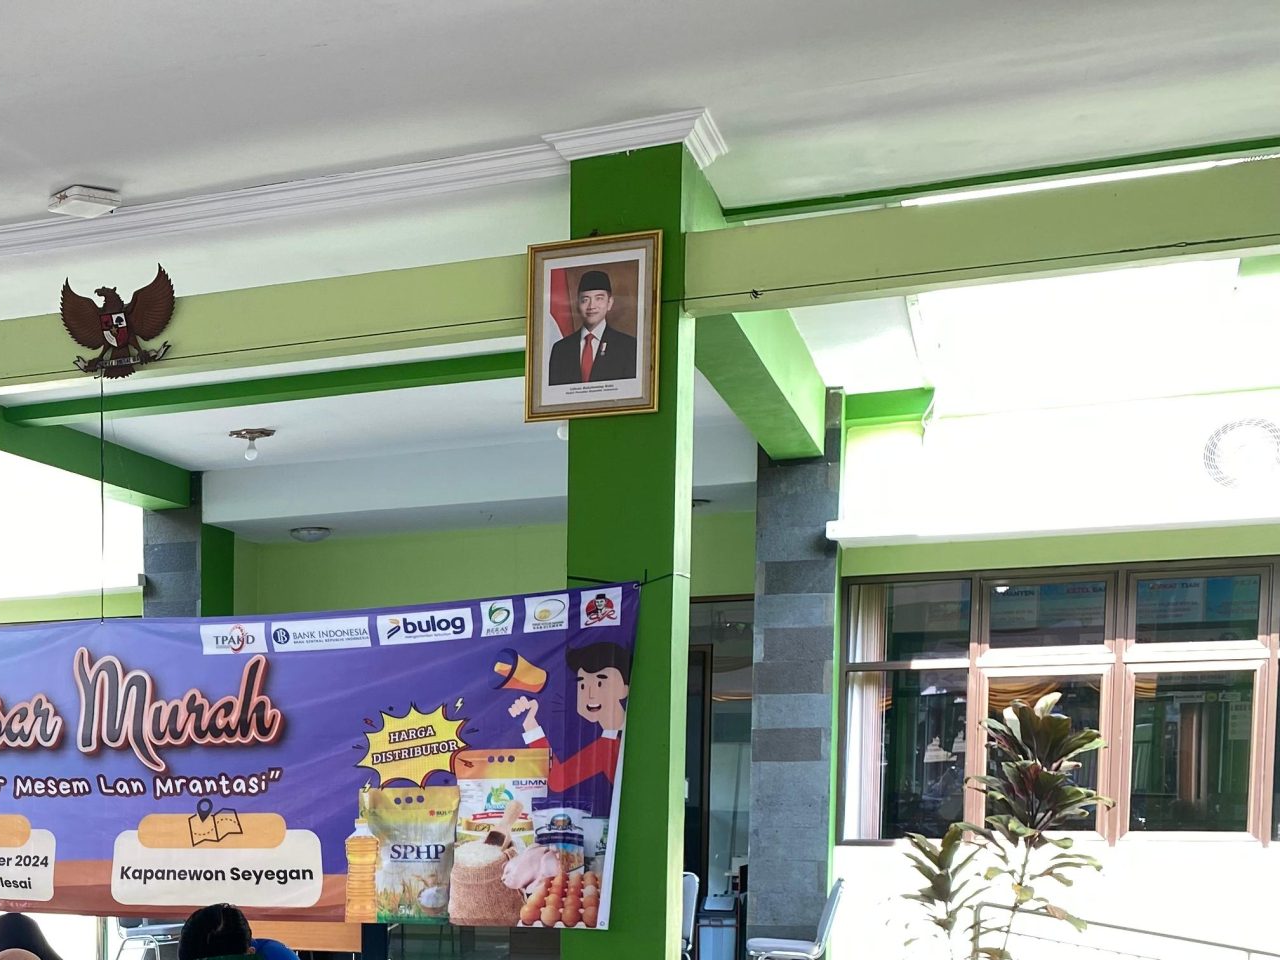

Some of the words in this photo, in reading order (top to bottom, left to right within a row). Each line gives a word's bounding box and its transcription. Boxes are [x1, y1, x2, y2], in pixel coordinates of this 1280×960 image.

[292, 631, 316, 641] BANK
[318, 628, 368, 639] INDONESIA
[402, 615, 466, 635] bulog
[73, 647, 281, 771] Murah
[389, 725, 436, 744] HARGA
[372, 740, 458, 765] DISTRIBUTOR
[14, 775, 90, 797] Mesem
[98, 774, 145, 796] Lan
[15, 855, 49, 868] 2024
[389, 844, 445, 860] SPHP
[120, 865, 226, 885] Kapanewon
[230, 867, 314, 885] Seyegan
